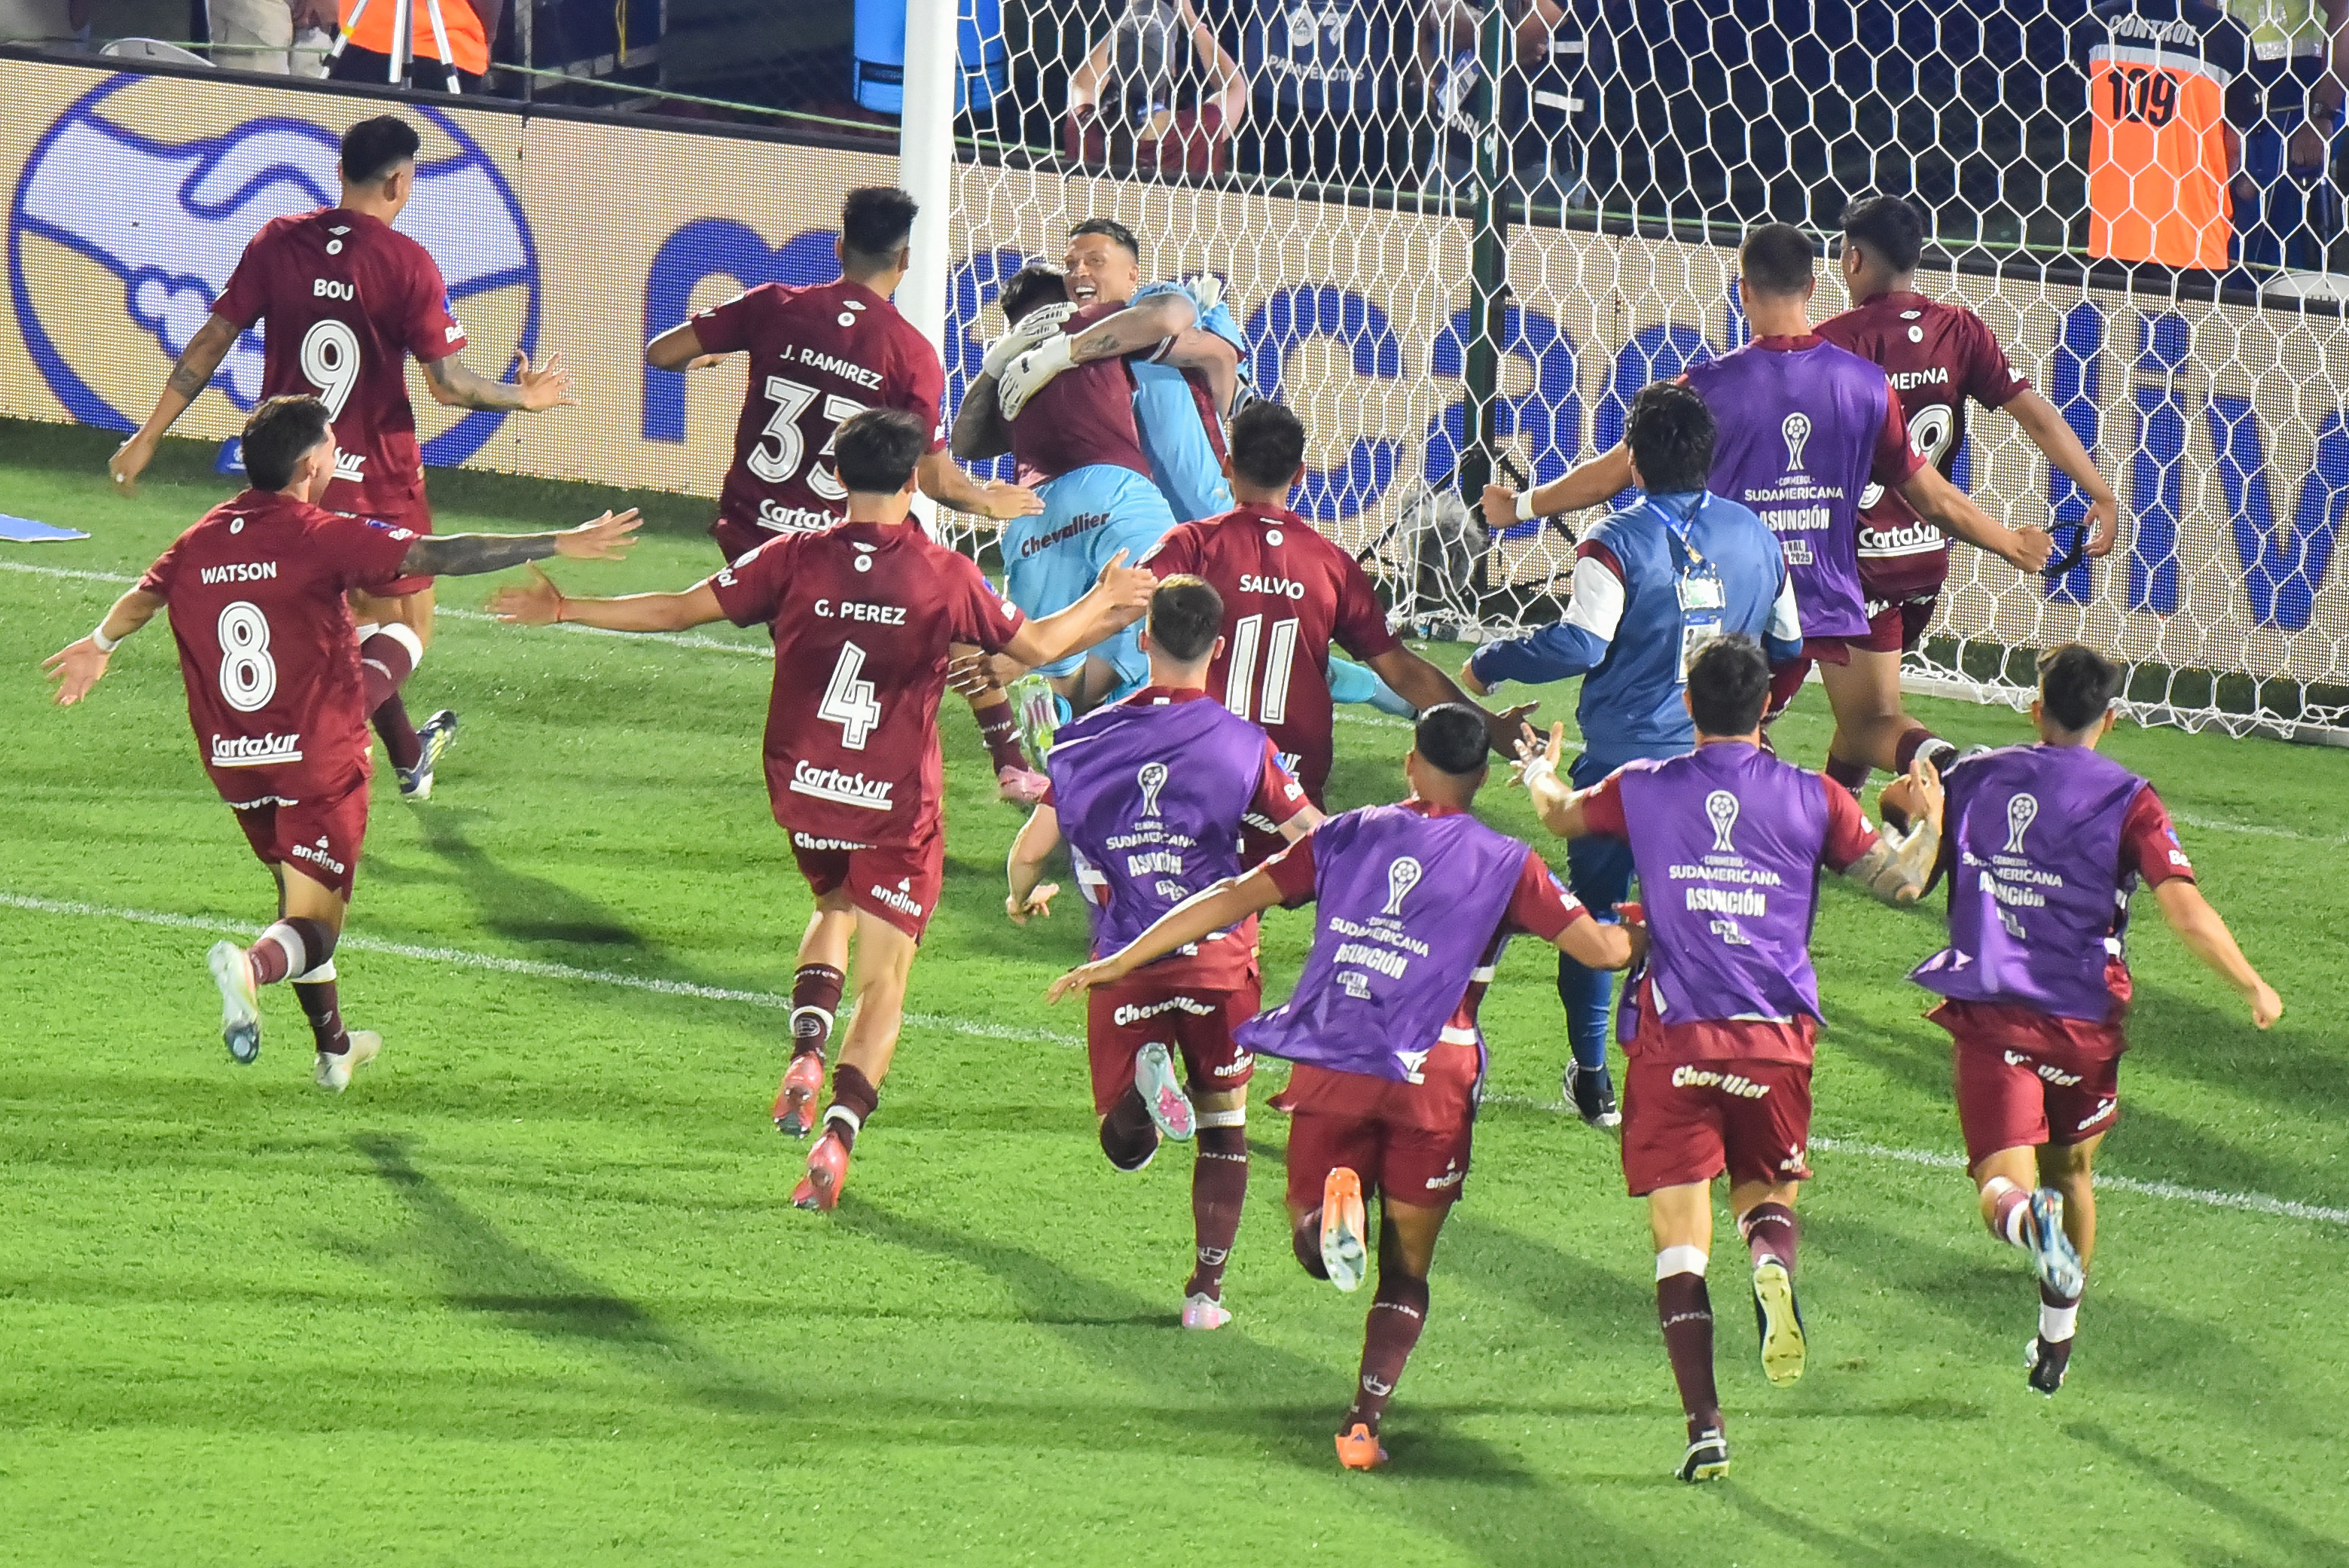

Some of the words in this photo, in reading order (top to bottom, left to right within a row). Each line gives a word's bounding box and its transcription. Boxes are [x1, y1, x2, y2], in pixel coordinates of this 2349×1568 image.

[2109, 14, 2198, 47] CONTROL
[2107, 66, 2179, 127] 109
[313, 278, 354, 301] BOU
[300, 319, 361, 423] 9
[779, 344, 795, 361] J.
[800, 348, 884, 391] RAMIREZ
[1744, 487, 1844, 502] SUDAMERICANA
[759, 499, 842, 530] CartaS
[1020, 511, 1111, 558] Chevallier
[200, 560, 277, 585] WATSON
[1239, 574, 1305, 600] SALVIO
[814, 599, 834, 618] G.
[840, 602, 908, 626] PEREZ
[218, 600, 277, 712] 8
[1225, 613, 1300, 725] 11
[816, 640, 882, 751] 4
[212, 732, 300, 758] CartaSur
[795, 759, 894, 801] CartaSur
[1106, 831, 1197, 850] SUDAMERCANA
[291, 844, 345, 874] andina
[1669, 865, 1781, 886] SUDAMERICANA
[871, 884, 923, 917] andina
[1686, 887, 1766, 917] ASUNCIÓN
[1672, 1064, 1771, 1099] Chevllier
